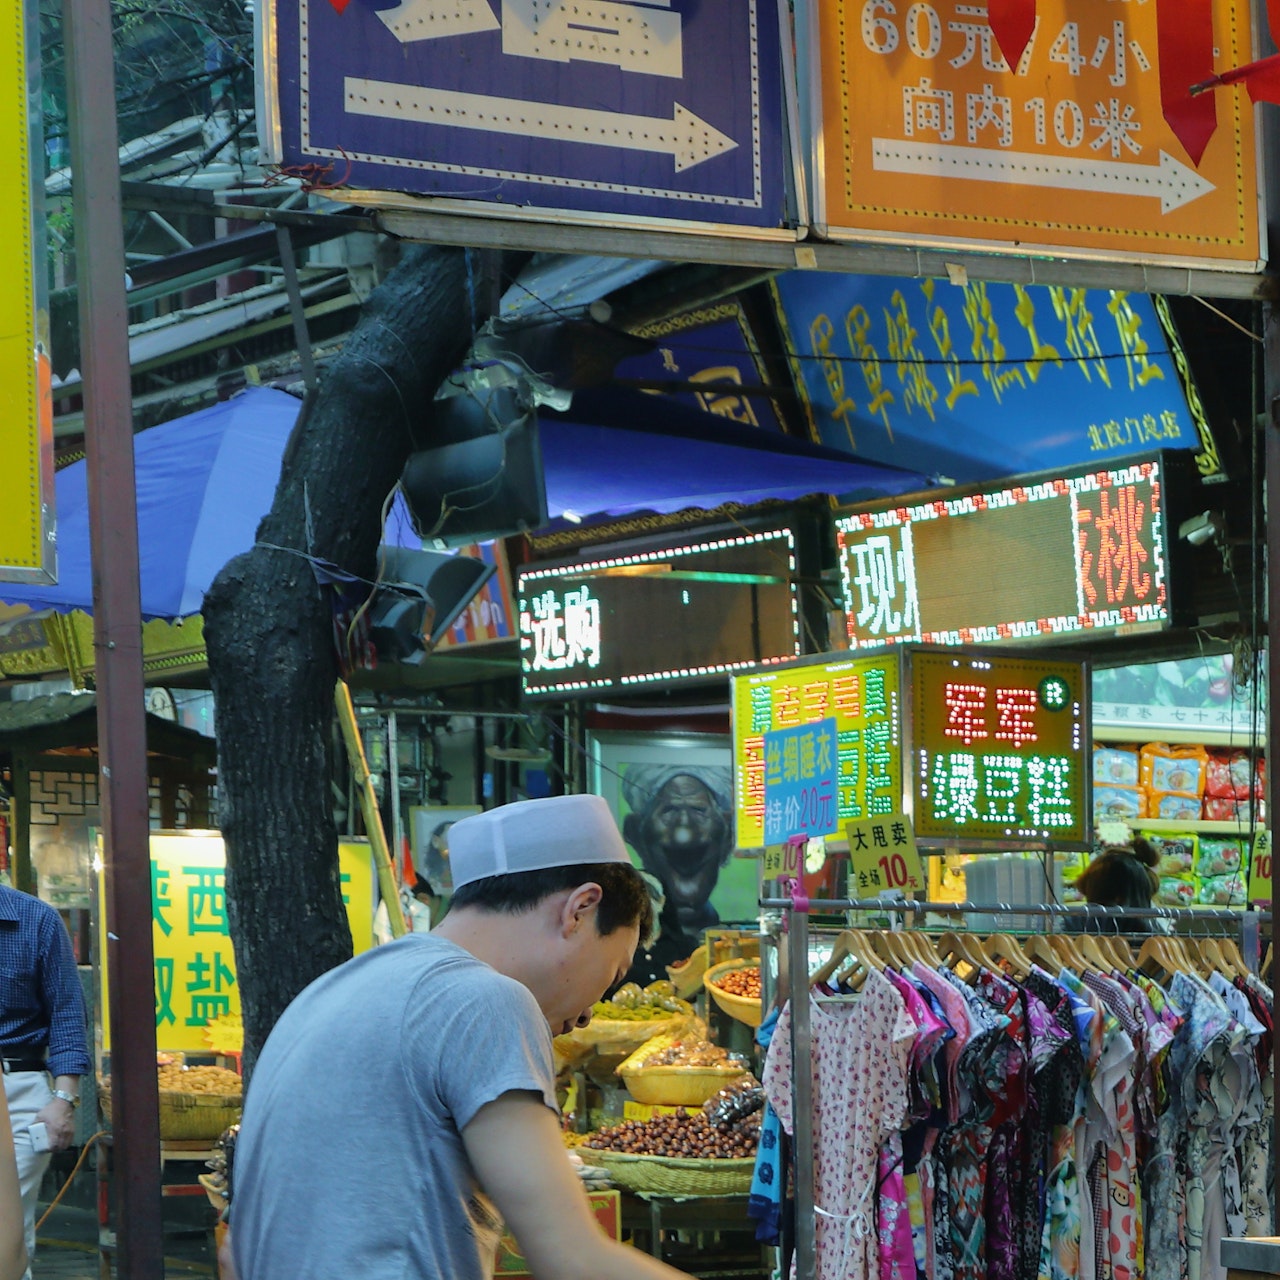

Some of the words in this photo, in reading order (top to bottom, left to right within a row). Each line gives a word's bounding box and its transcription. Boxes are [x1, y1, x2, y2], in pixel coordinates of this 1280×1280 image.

[861, 0, 1219, 86] 60元/4小
[901, 77, 1142, 158] 向内10米
[1088, 411, 1182, 452] 北院门总店
[521, 584, 600, 672] 选购
[945, 683, 1038, 748] 军军
[766, 730, 833, 786] 丝绸睡衣
[932, 751, 1074, 827] 绿豆糕
[765, 778, 833, 838] 特价20元
[852, 822, 909, 852] 大甩卖
[858, 852, 920, 890] 全场10元
